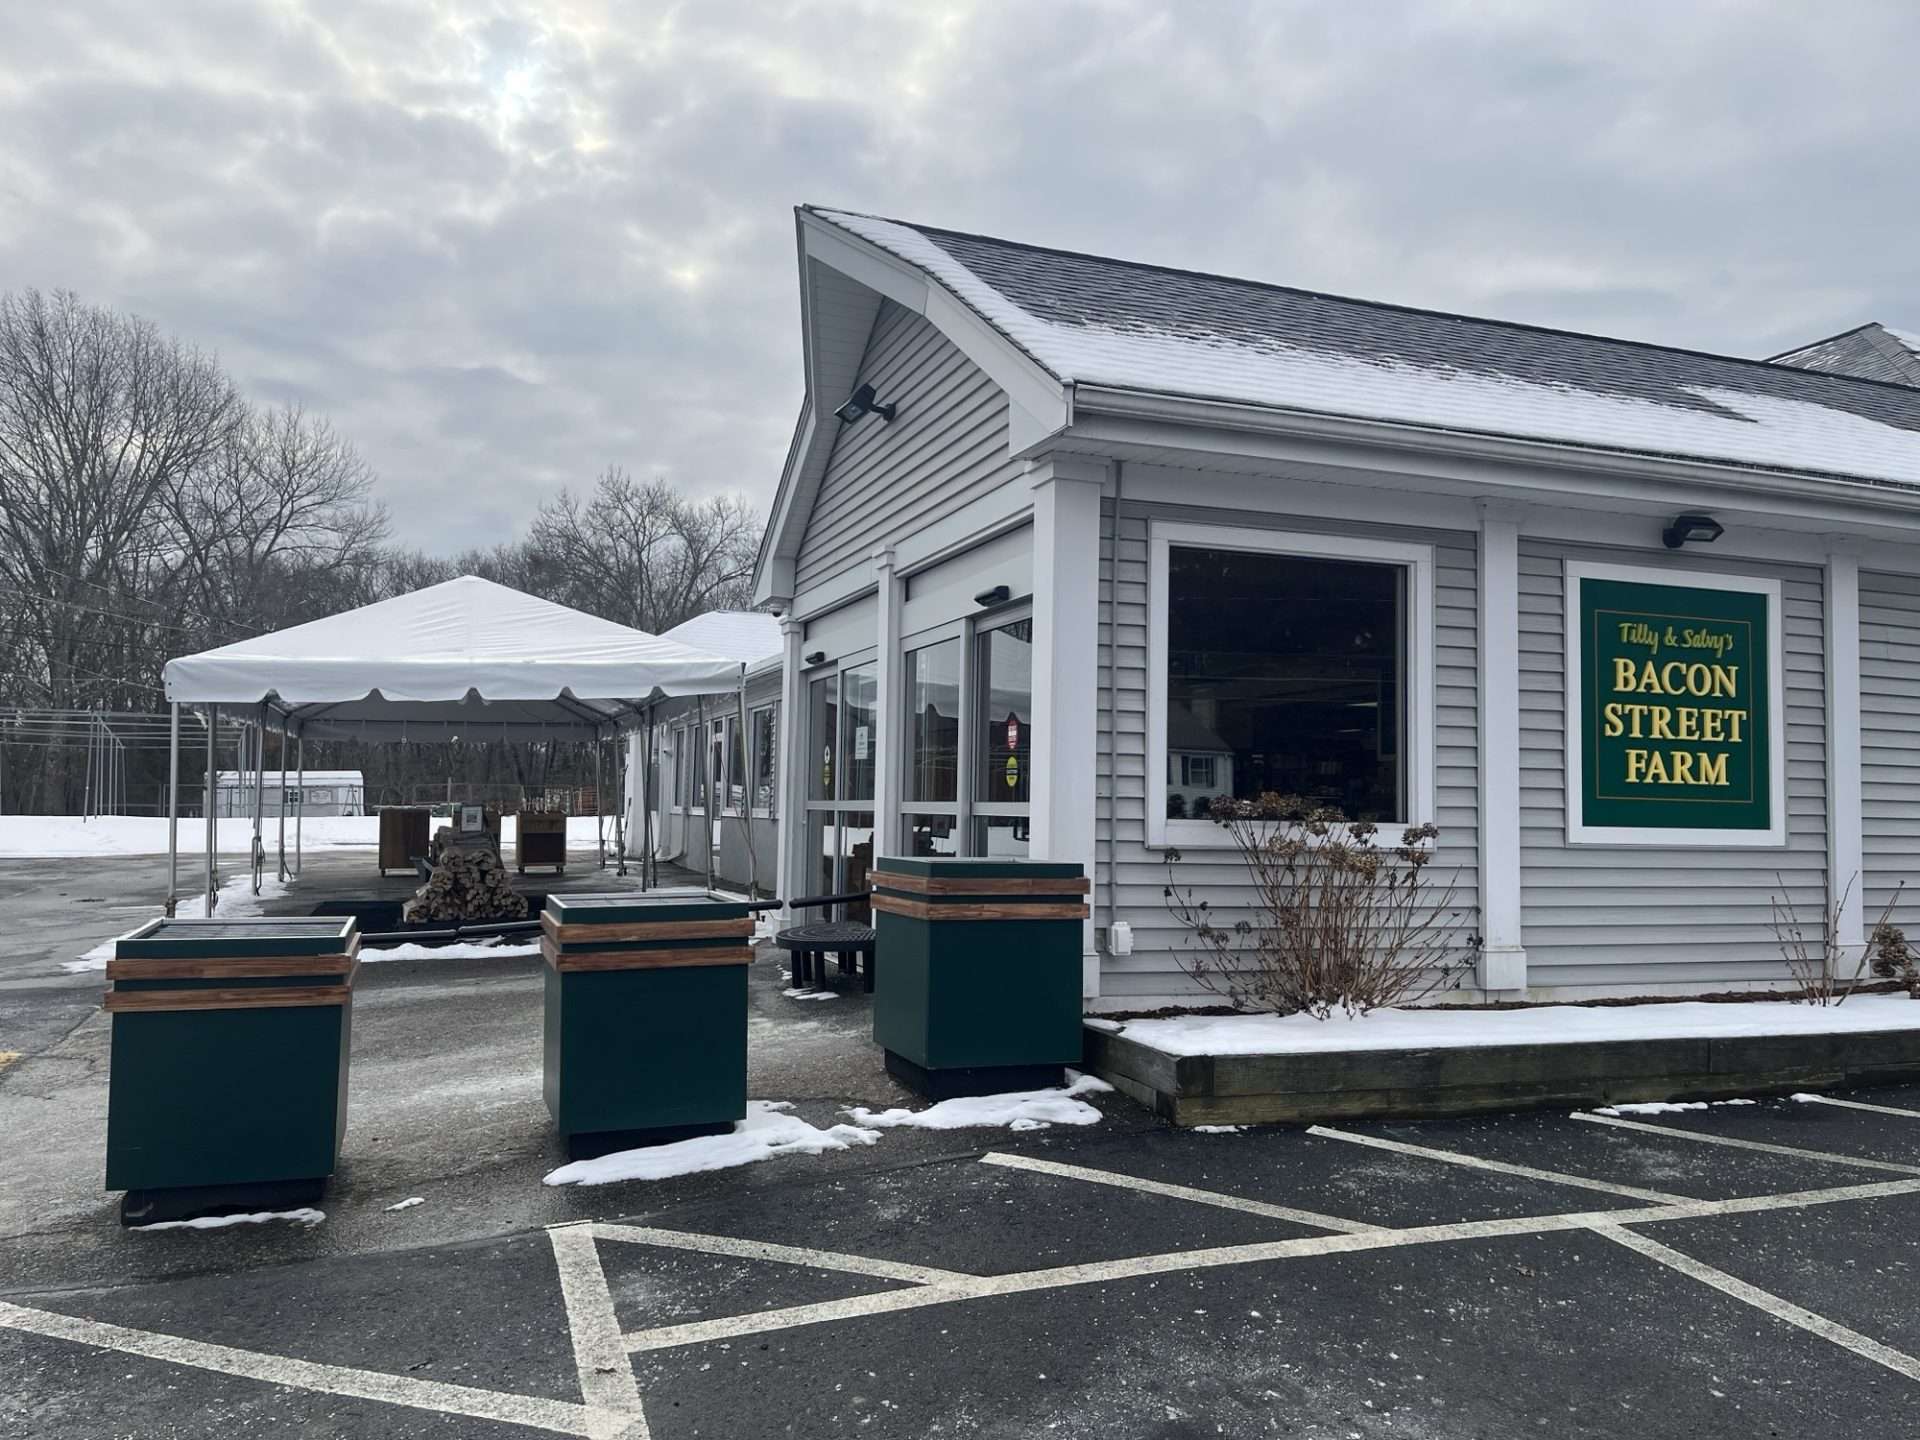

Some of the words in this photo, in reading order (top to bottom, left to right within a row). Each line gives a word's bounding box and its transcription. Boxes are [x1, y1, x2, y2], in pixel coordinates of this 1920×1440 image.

[1618, 622, 1659, 655] Tilly
[1664, 625, 1679, 648] &
[1681, 628, 1734, 659] Salvy's
[1612, 658, 1739, 698] BACON
[1604, 703, 1747, 742] STREET
[1625, 749, 1730, 786] FARM
